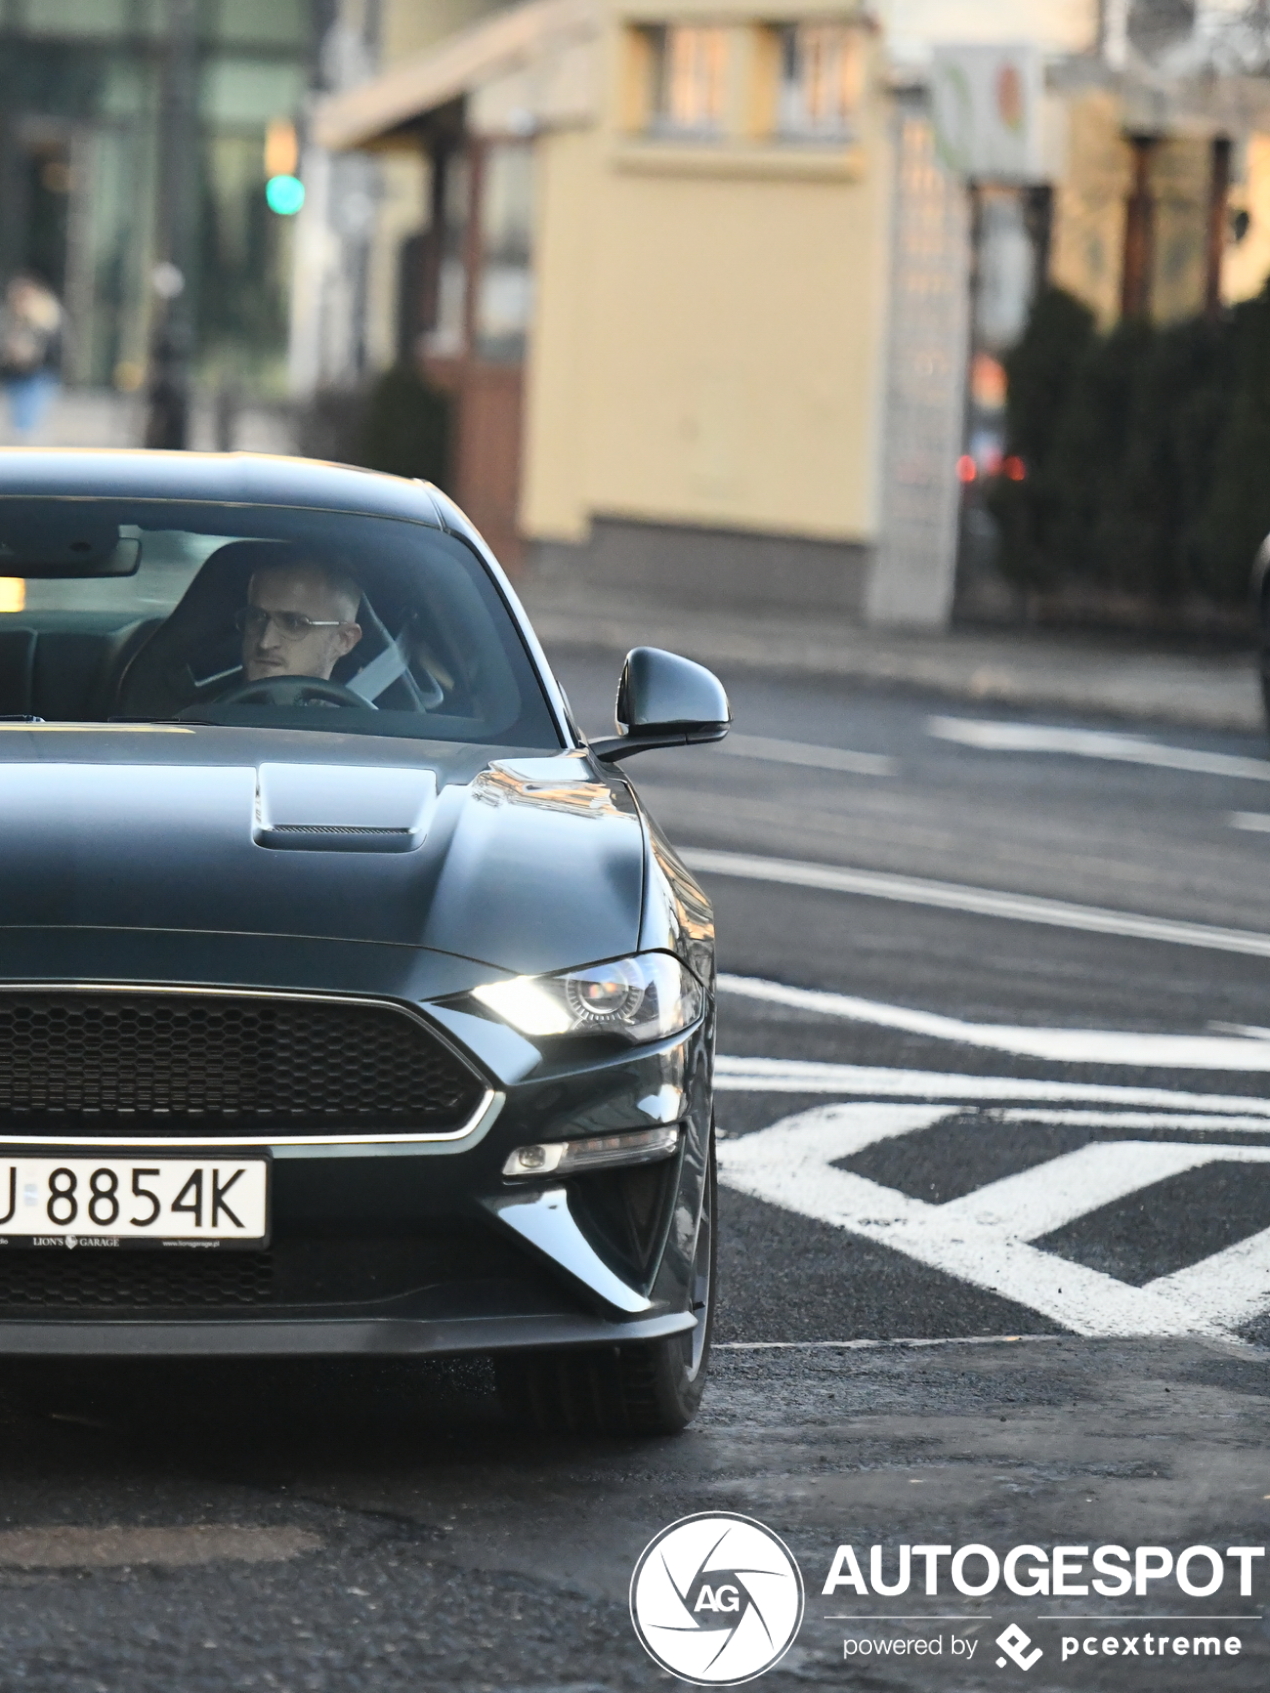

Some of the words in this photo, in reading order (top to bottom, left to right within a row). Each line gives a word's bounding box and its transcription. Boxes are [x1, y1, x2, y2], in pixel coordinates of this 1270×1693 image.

[47, 1167, 246, 1228] 8854K
[33, 1237, 64, 1247] LION'S
[79, 1238, 120, 1247] GARAGE
